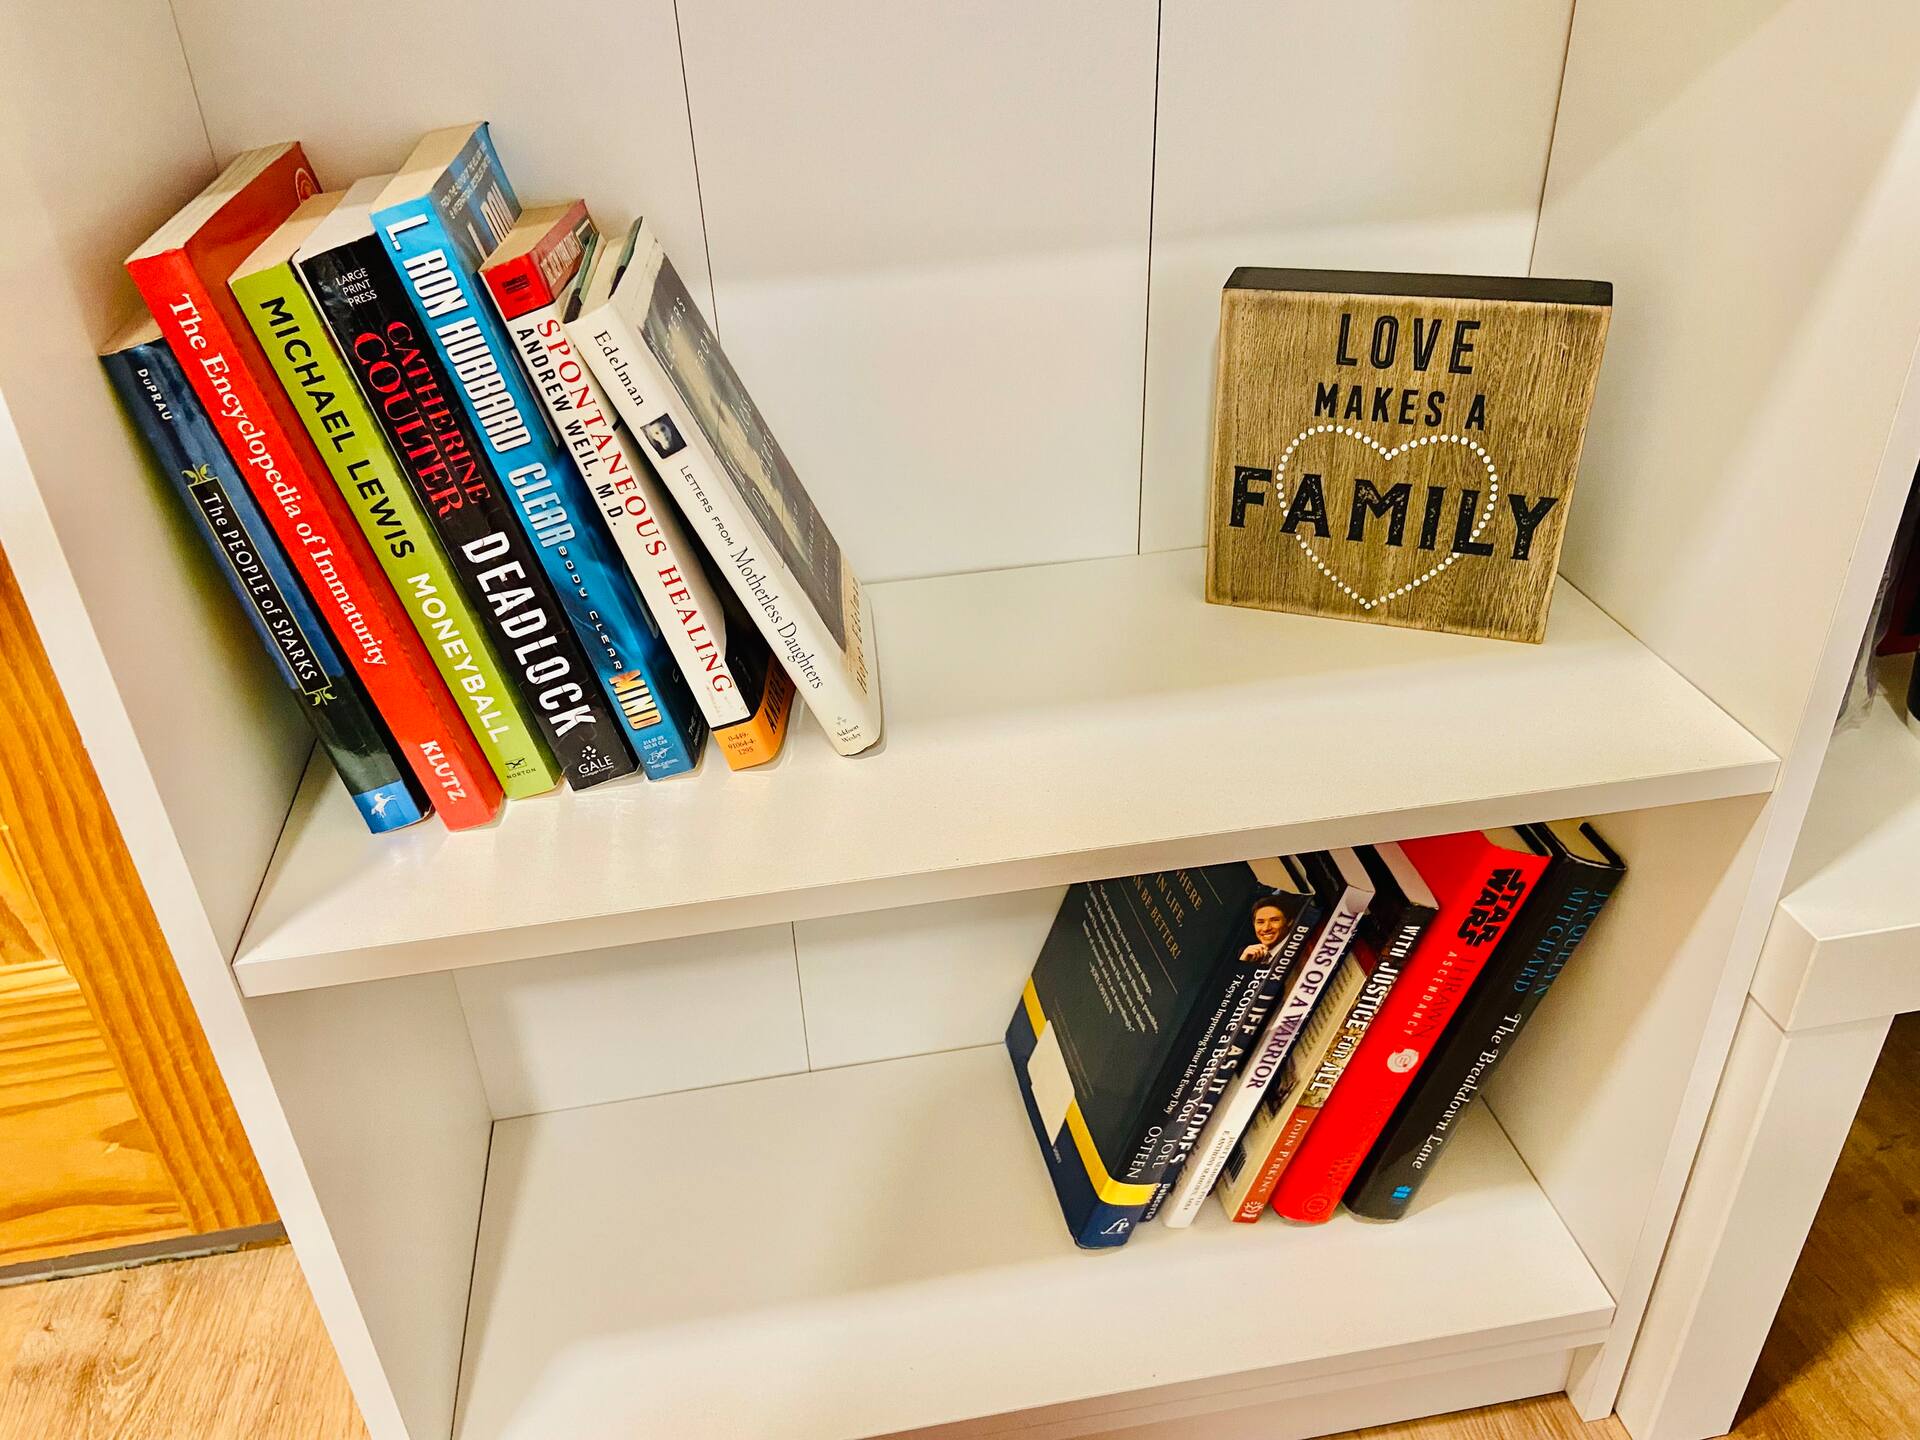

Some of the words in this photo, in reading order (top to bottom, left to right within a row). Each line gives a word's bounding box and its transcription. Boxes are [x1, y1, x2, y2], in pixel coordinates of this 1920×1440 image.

[335, 266, 368, 287] LARGE
[342, 279, 373, 298] PRINT
[348, 290, 378, 308] PRESS
[402, 248, 468, 319] RON
[436, 315, 532, 453] HUBBARD
[593, 329, 645, 407] Edelman
[1335, 313, 1481, 375] LOVE
[354, 332, 465, 520] COULTER
[385, 320, 491, 506] CATHERINE
[516, 327, 573, 413] ANDREW
[595, 481, 624, 526] M.D.
[1313, 382, 1446, 427] MAKES
[1464, 393, 1486, 430] A
[169, 293, 208, 350] The
[200, 352, 302, 520] Encyclopedia
[296, 522, 322, 546] of
[309, 546, 388, 669] Immaturity
[260, 296, 354, 454] MICHAEL
[347, 459, 415, 559] LEWIS
[407, 572, 510, 744] MONEYBALL
[537, 319, 667, 557] SPONTANEOUS
[657, 565, 735, 694] HEALING
[1228, 465, 1559, 561] FAMILY
[203, 491, 228, 527] The
[221, 528, 272, 597] PEOPLE
[261, 599, 277, 617] of
[272, 618, 318, 681] SPARKS
[508, 461, 577, 549] CLEAR
[558, 545, 590, 600] BODY
[589, 609, 622, 671] CLEAR
[608, 669, 663, 731] MIND
[680, 465, 714, 514] LETTERS
[711, 515, 736, 547] FROM
[730, 545, 783, 625] Motherless
[777, 621, 824, 690] Daughters
[461, 530, 597, 738] DEADLOCK
[506, 767, 537, 780] NORTON
[578, 755, 614, 774] GALE
[1457, 868, 1516, 945] WARS
[1471, 868, 1526, 947] STAR
[1270, 925, 1309, 981] BONDOUX
[1315, 911, 1359, 967] TEARS
[1389, 924, 1421, 958] WITH
[1514, 887, 1589, 993] MITCHARD
[1221, 999, 1230, 1007] to
[1225, 980, 1241, 998] Keys
[1225, 968, 1271, 1031] Become
[1289, 995, 1308, 1008] A
[1300, 970, 1324, 995] OF
[1343, 961, 1398, 1033] JUSTICE
[1403, 950, 1457, 1035] ASCENDANCY
[1198, 1008, 1226, 1046] Improving
[1218, 1034, 1231, 1044] a
[1246, 1013, 1300, 1089] WARRIOR
[1331, 1034, 1357, 1060] FOR
[1490, 1013, 1522, 1046] The
[1183, 1064, 1197, 1078] Life
[1192, 1045, 1207, 1063] Your
[1193, 1047, 1229, 1093] Better
[1308, 1059, 1345, 1093] ALL
[1163, 1100, 1178, 1114] Day
[1171, 1079, 1189, 1099] Every
[1175, 1094, 1203, 1123] You
[1435, 1049, 1499, 1132] Breakdown
[1126, 1126, 1162, 1178] OSTEEN
[1152, 1139, 1177, 1168] JOEL
[1283, 1118, 1308, 1147] JOHN
[1412, 1133, 1443, 1171] Lane
[1257, 1149, 1291, 1193] PERKINS
